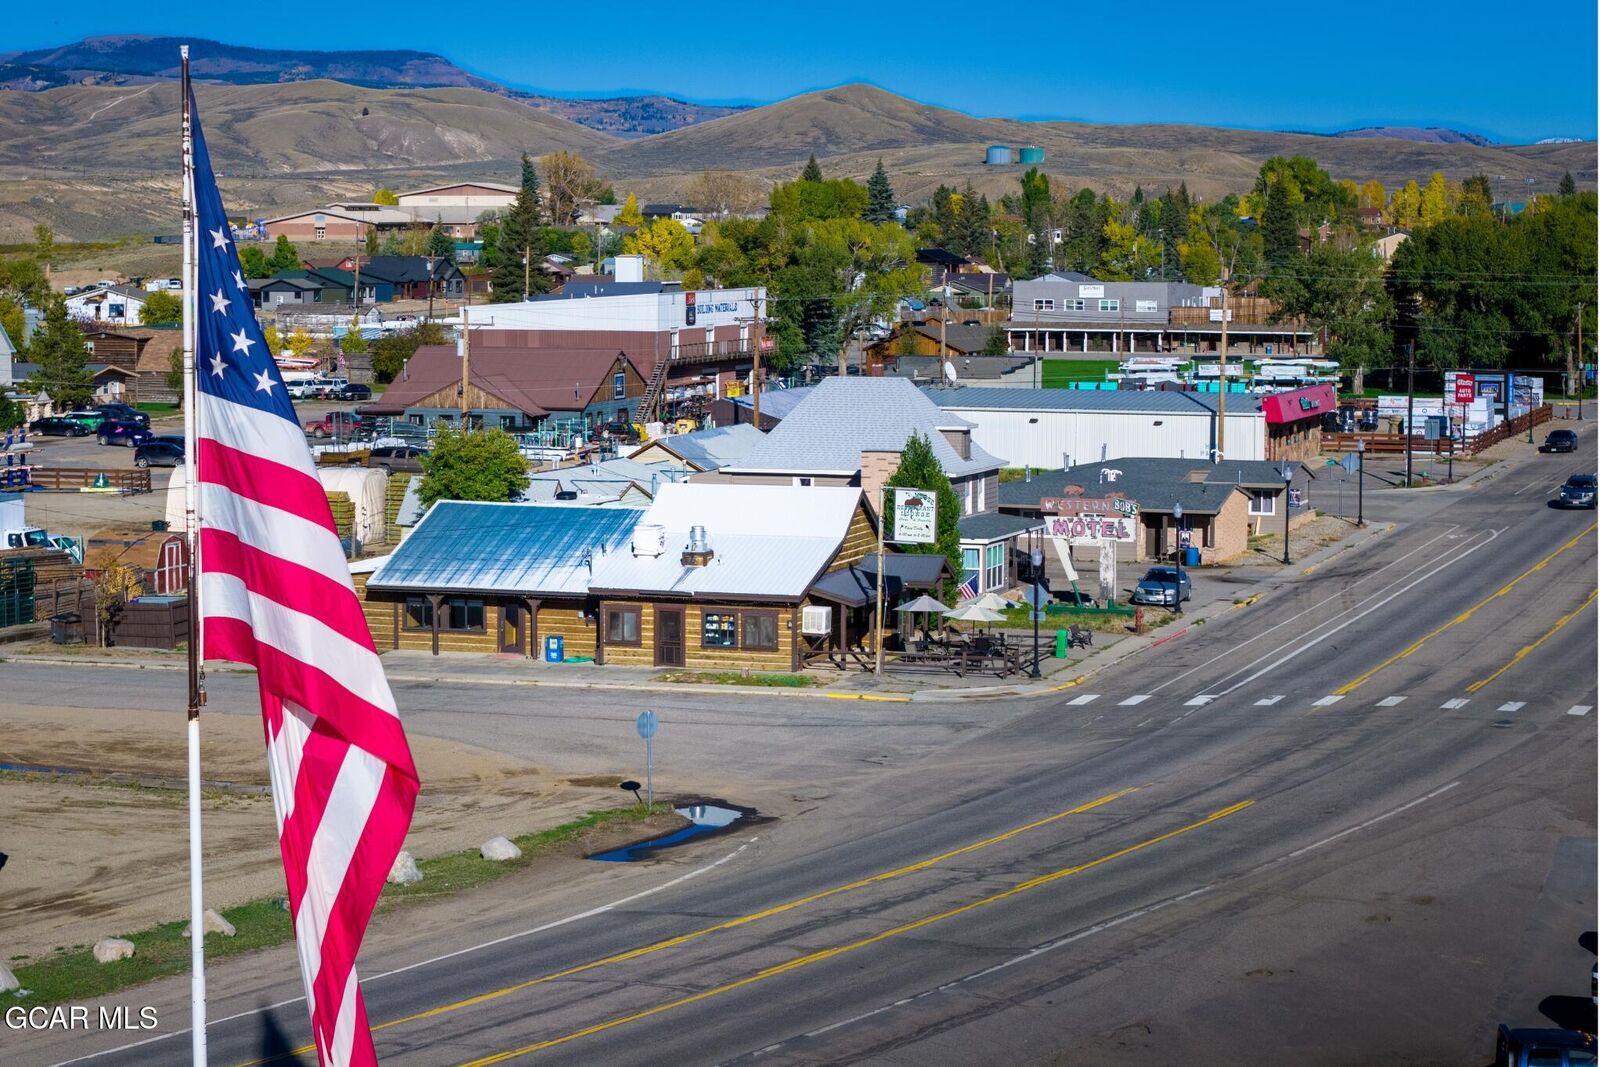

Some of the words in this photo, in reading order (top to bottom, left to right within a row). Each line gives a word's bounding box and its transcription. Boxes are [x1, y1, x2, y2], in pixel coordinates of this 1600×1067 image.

[697, 304, 713, 314] BUILDING
[715, 302, 737, 313] MATERIALS
[1044, 499, 1110, 512] WESTERN
[1052, 519, 1131, 540] MOTEL
